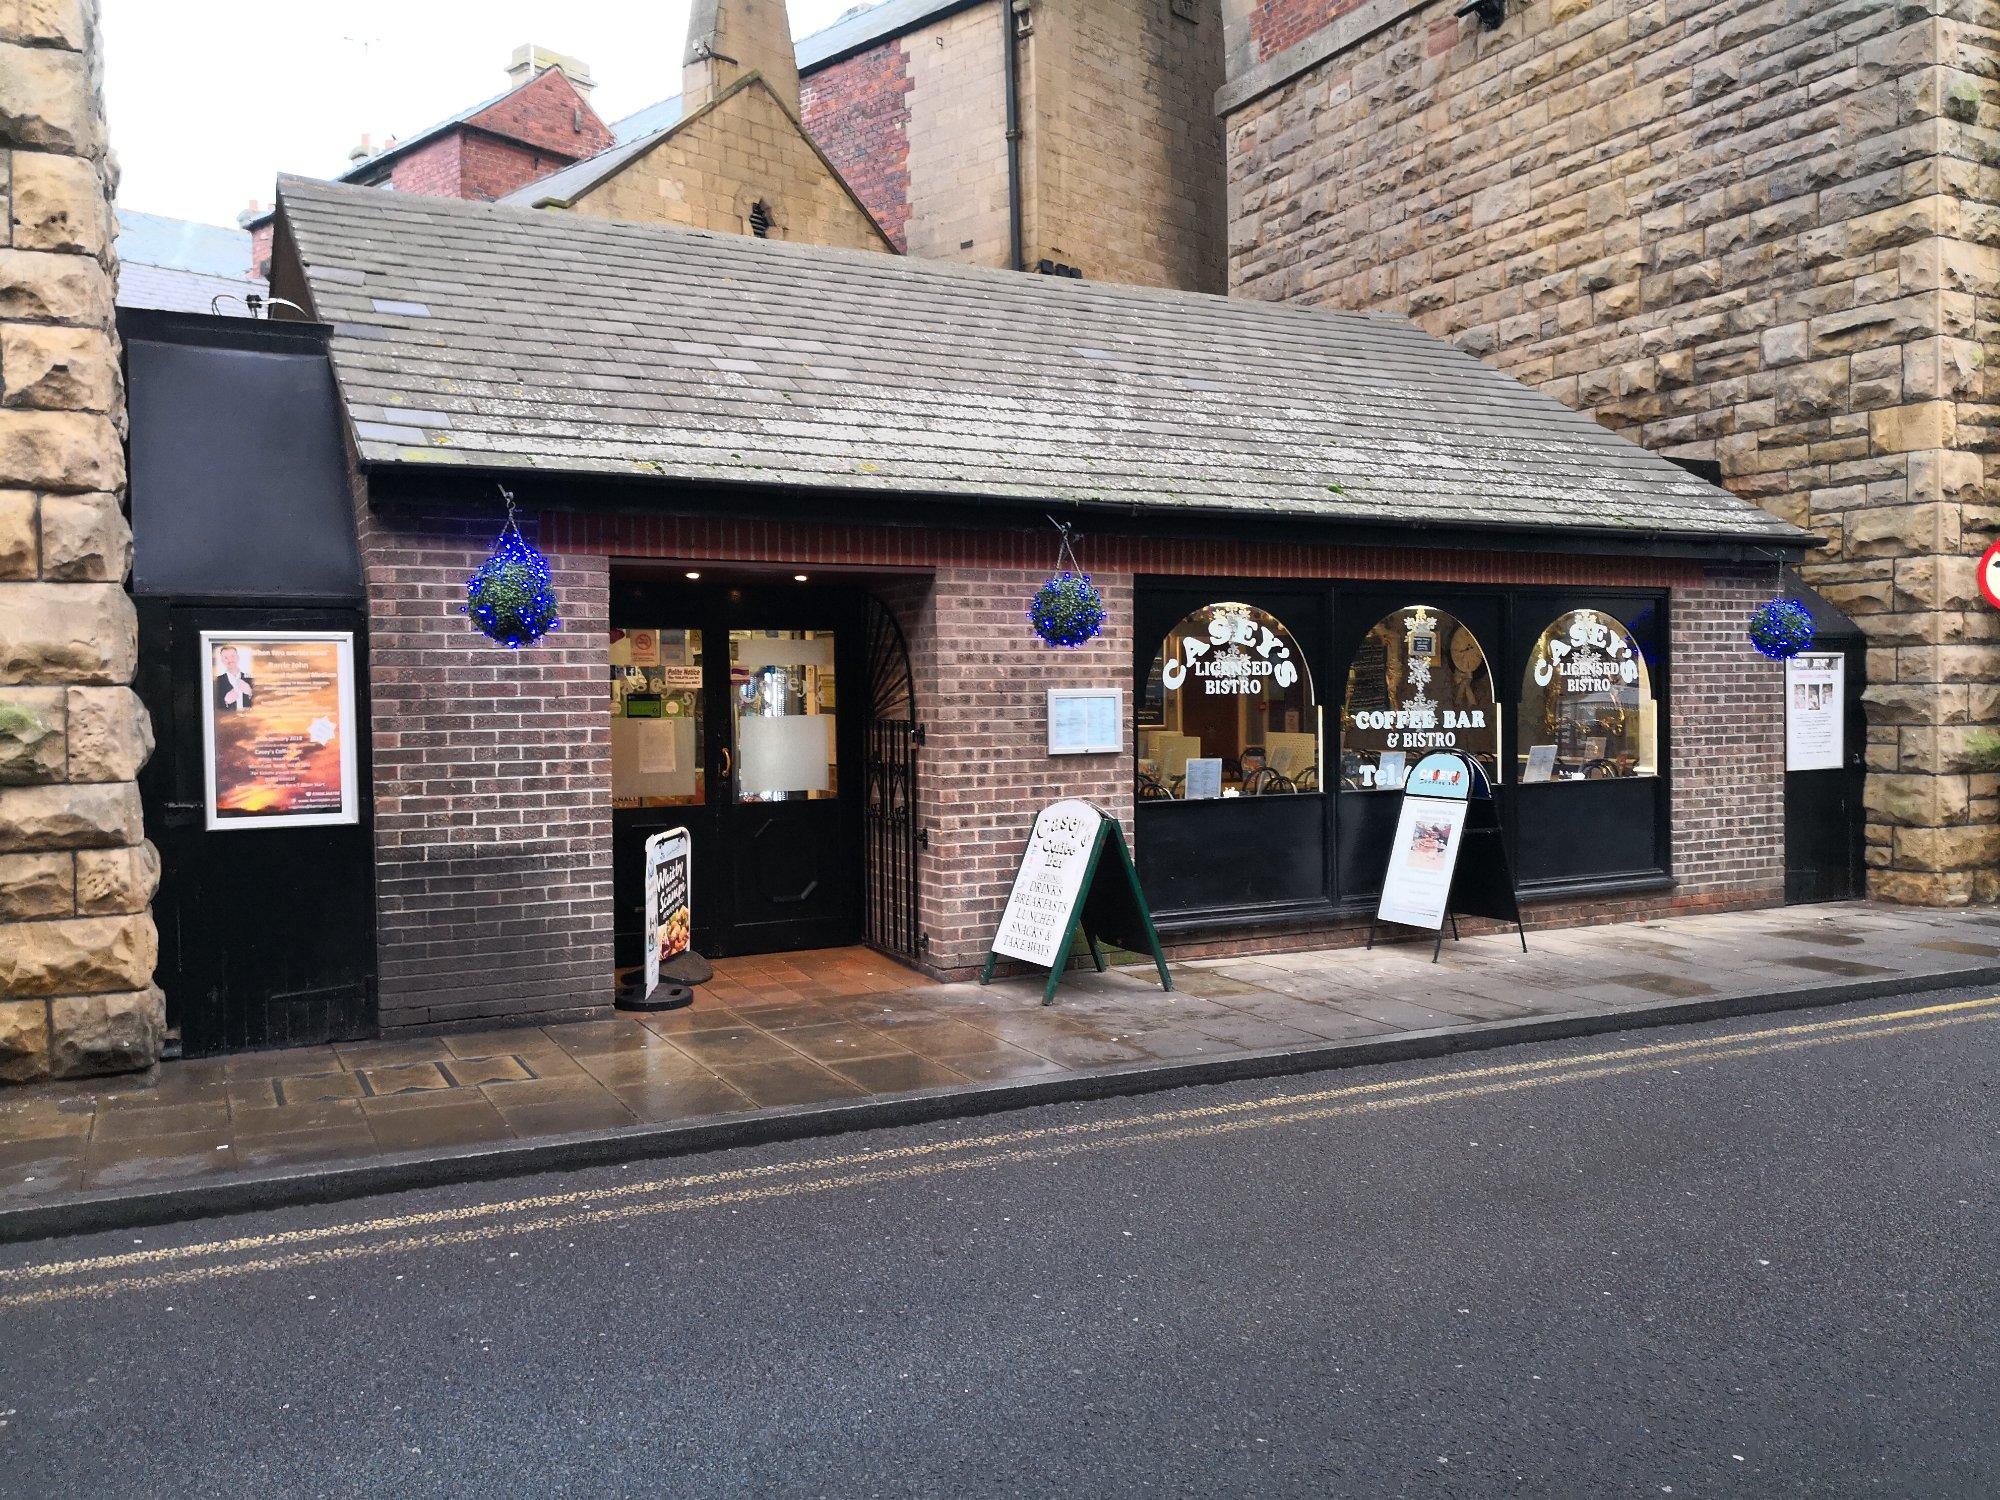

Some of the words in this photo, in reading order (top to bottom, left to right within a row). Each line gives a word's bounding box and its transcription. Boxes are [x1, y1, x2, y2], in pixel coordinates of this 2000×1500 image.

[1163, 618, 1298, 690] CASEY'S
[1534, 622, 1638, 687] CASEY'S
[1195, 661, 1273, 676] LICENSED
[1560, 662, 1618, 676] LICENSED
[1205, 680, 1261, 695] BISTRO
[1567, 678, 1611, 692] BISTRO
[1355, 711, 1435, 729] COFFEE
[1443, 711, 1486, 729] BAR
[1386, 733, 1399, 748] &
[1403, 732, 1456, 747] BISTRO
[656, 859, 684, 892] Whitby
[1029, 881, 1063, 897] DRINKS
[1014, 893, 1069, 913] BREAKFASTS
[1015, 907, 1057, 926] LUNCHES
[1011, 922, 1044, 938] SNACKS
